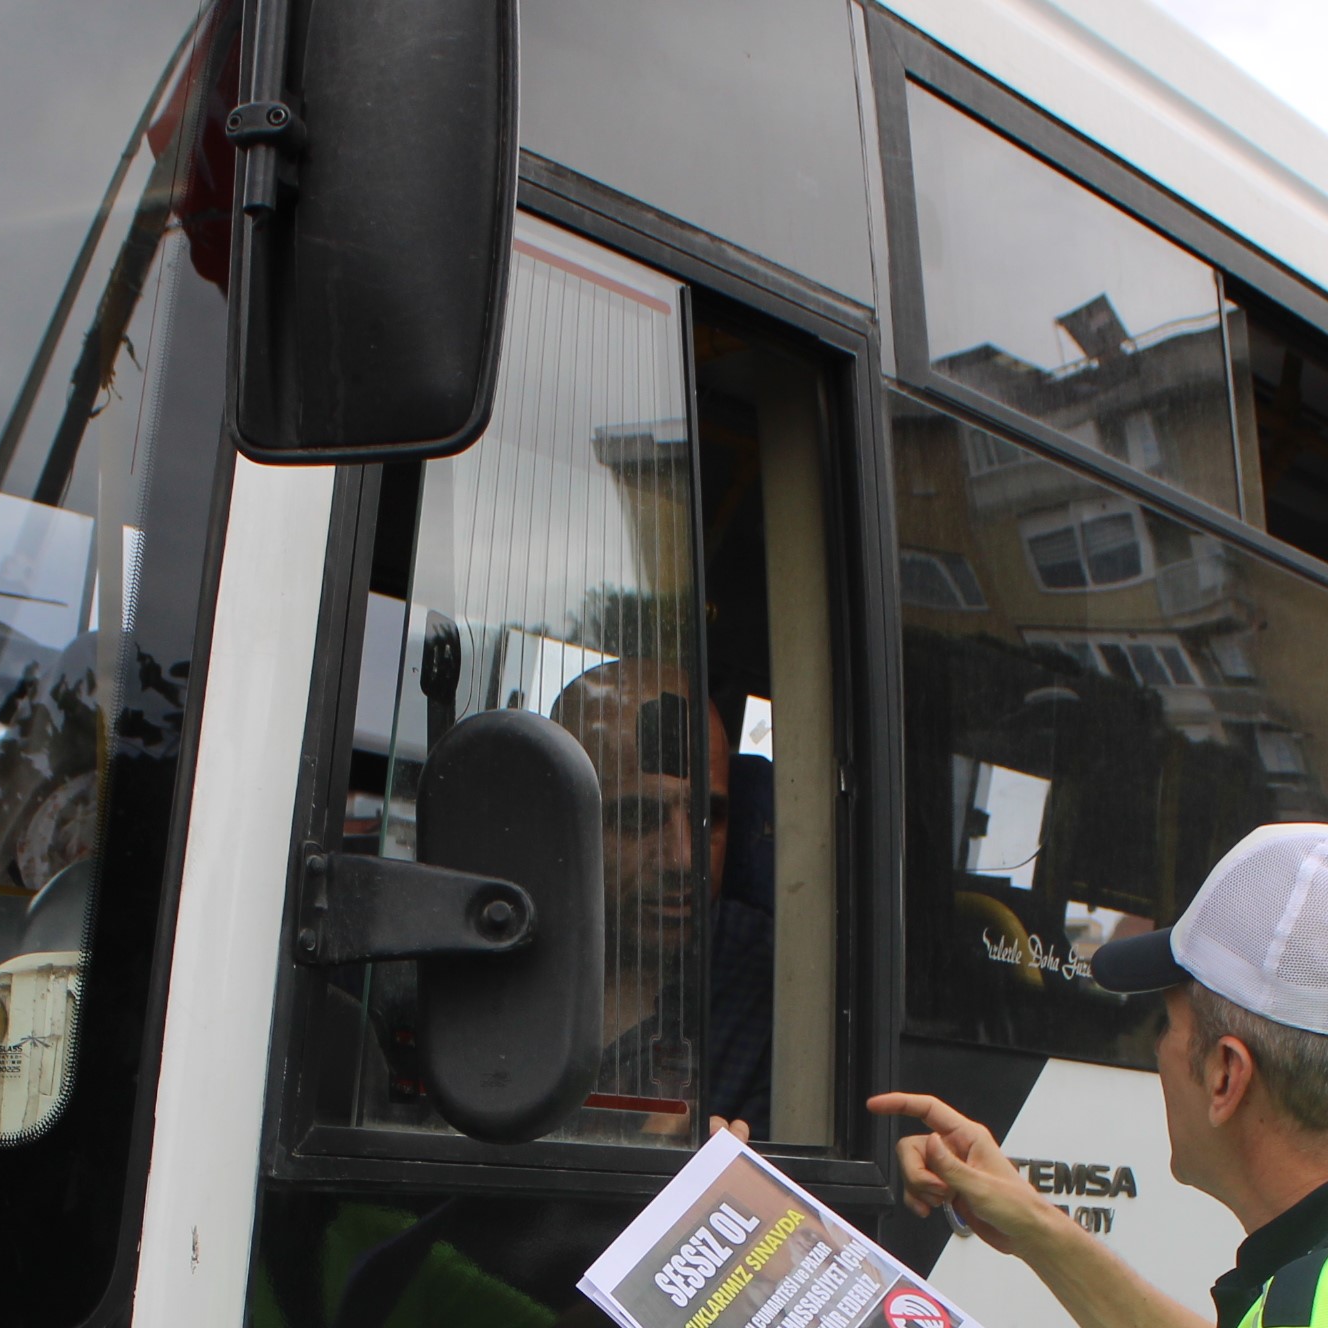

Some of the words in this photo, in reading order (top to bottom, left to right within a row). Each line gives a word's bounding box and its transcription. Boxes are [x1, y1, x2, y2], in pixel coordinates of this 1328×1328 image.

[654, 1225, 734, 1308] SESSİZ
[709, 1202, 761, 1245] OL
[745, 1208, 806, 1271] SINAVDA
[800, 1241, 833, 1275] PAZAR
[794, 1269, 810, 1284] ve
[837, 1272, 881, 1320] EDERİZ
